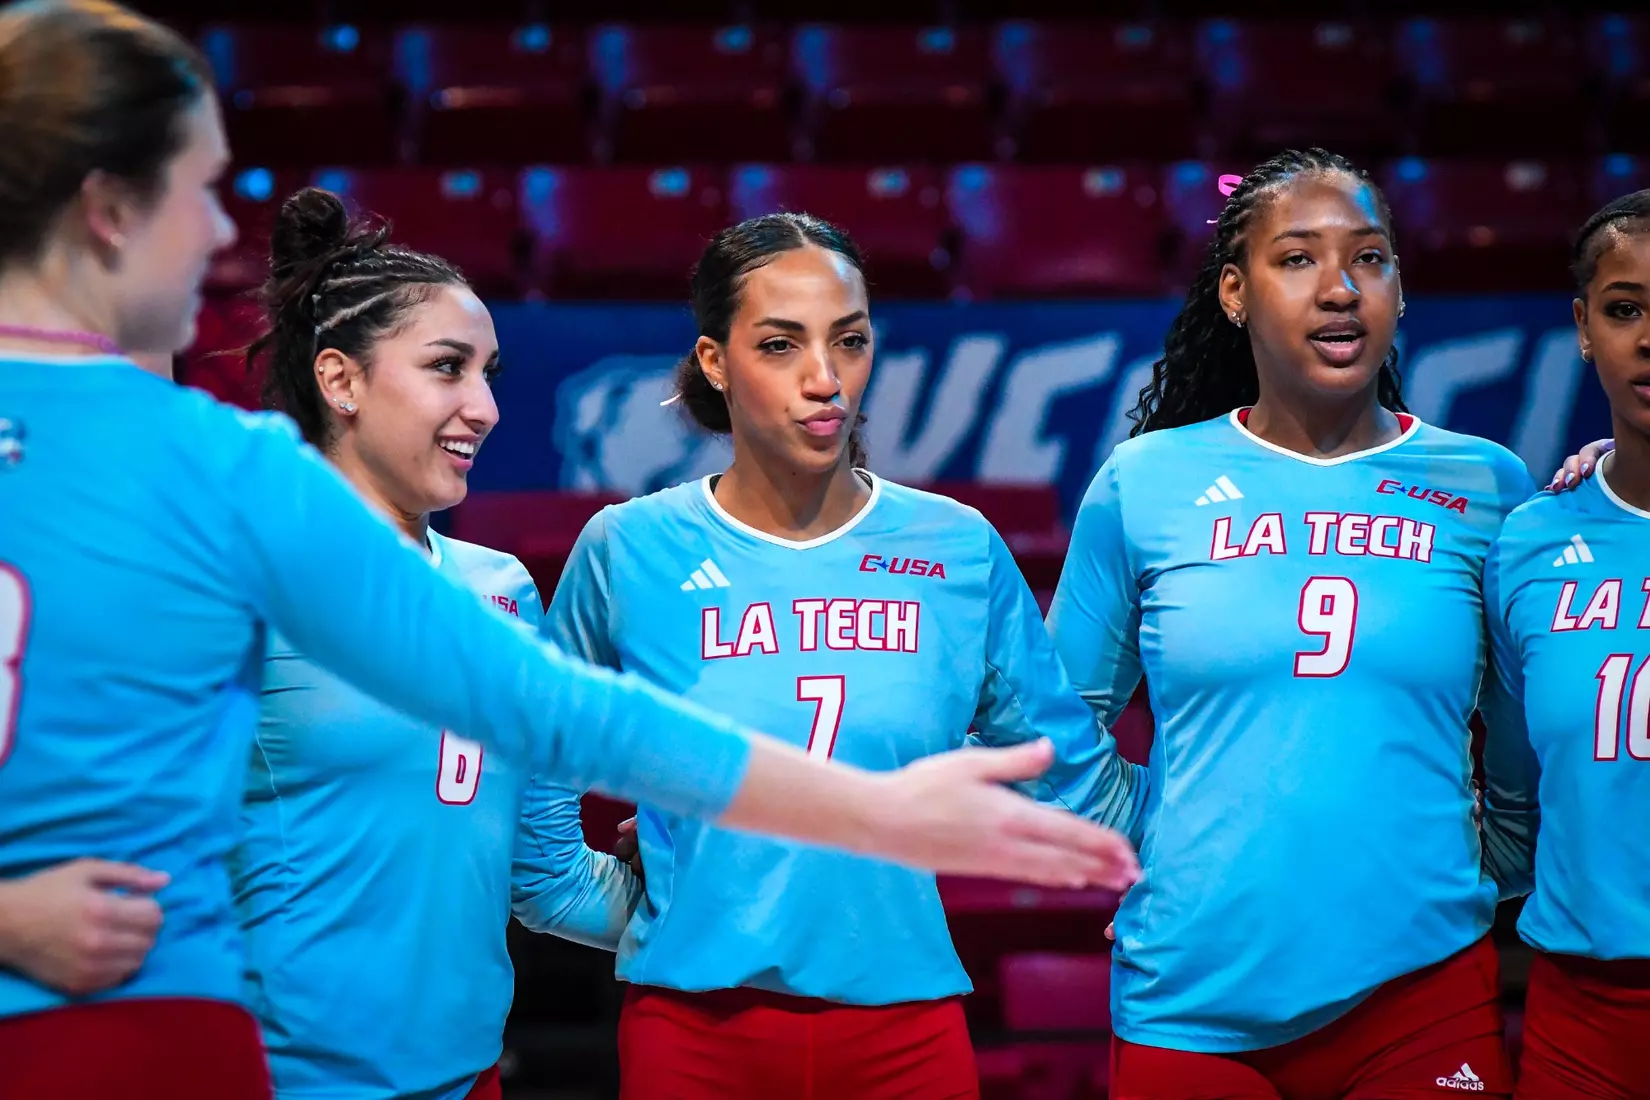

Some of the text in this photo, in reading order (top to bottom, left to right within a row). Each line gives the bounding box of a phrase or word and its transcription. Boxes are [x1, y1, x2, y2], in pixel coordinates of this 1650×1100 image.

[1210, 512, 1436, 563] LA TECH
[702, 598, 920, 660] LA TECH
[1293, 576, 1359, 678] 9
[1551, 578, 1622, 632] LA
[797, 675, 845, 761] 7
[1436, 1076, 1484, 1091] adidas
